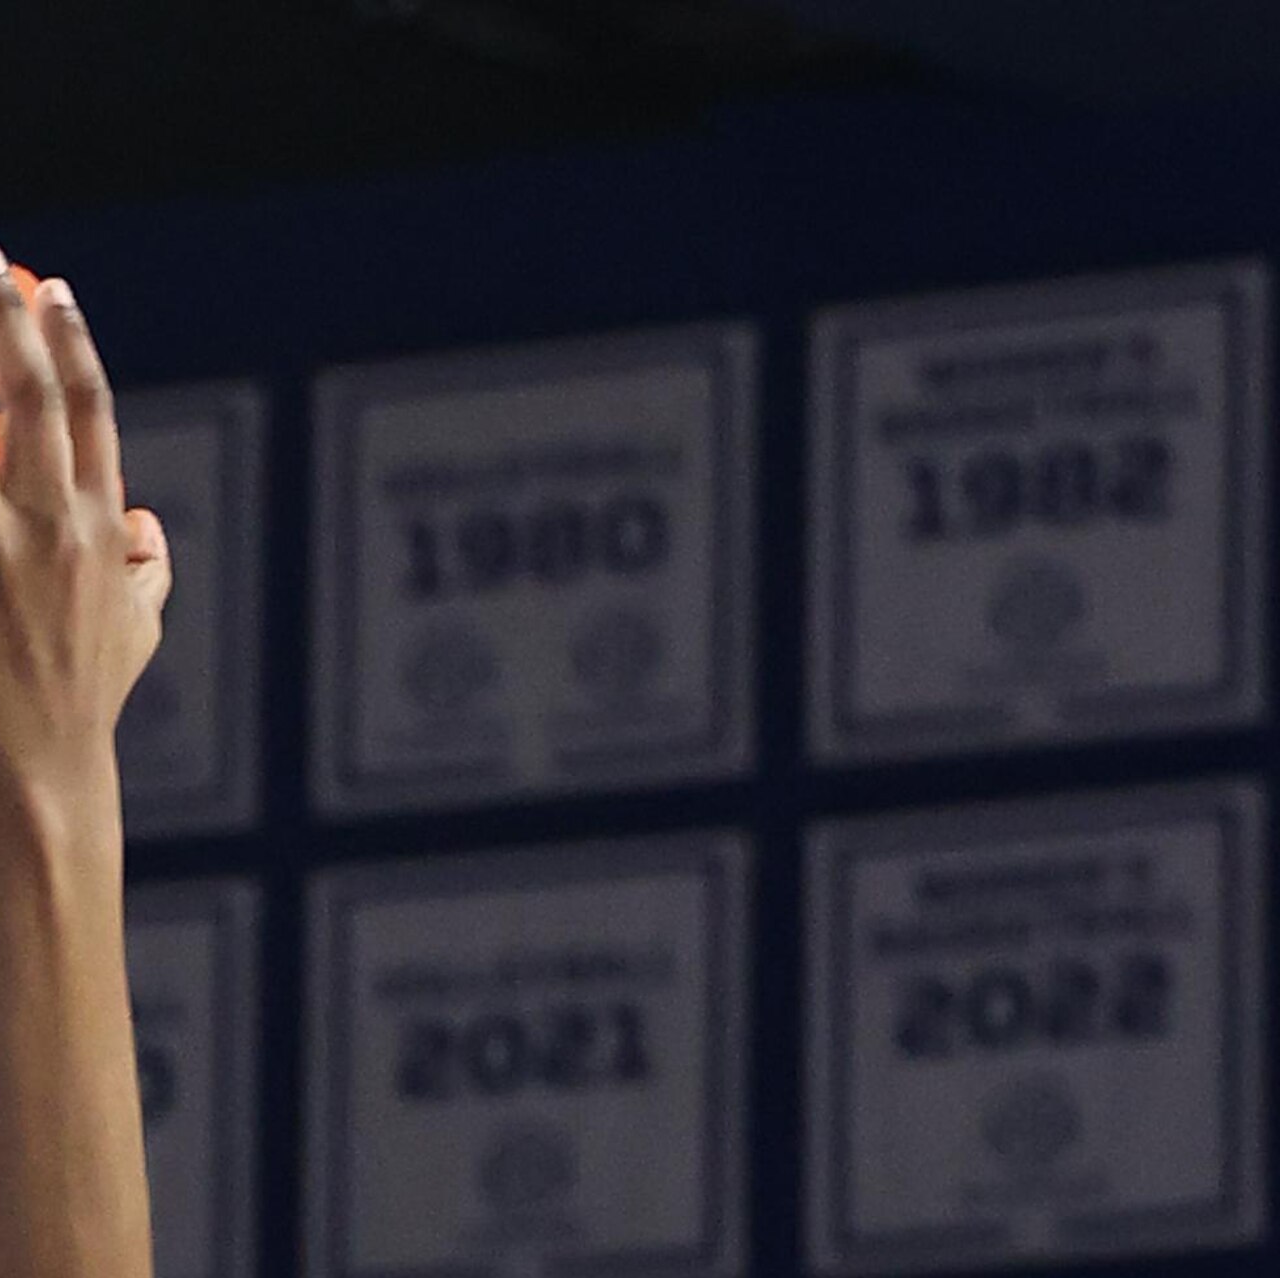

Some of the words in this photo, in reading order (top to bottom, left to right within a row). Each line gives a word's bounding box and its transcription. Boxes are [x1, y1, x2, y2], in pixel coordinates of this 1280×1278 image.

[903, 436, 1173, 544] 1982
[405, 496, 669, 600] 1980
[395, 1005, 649, 1103] 2021
[893, 953, 1170, 1062] 2022
